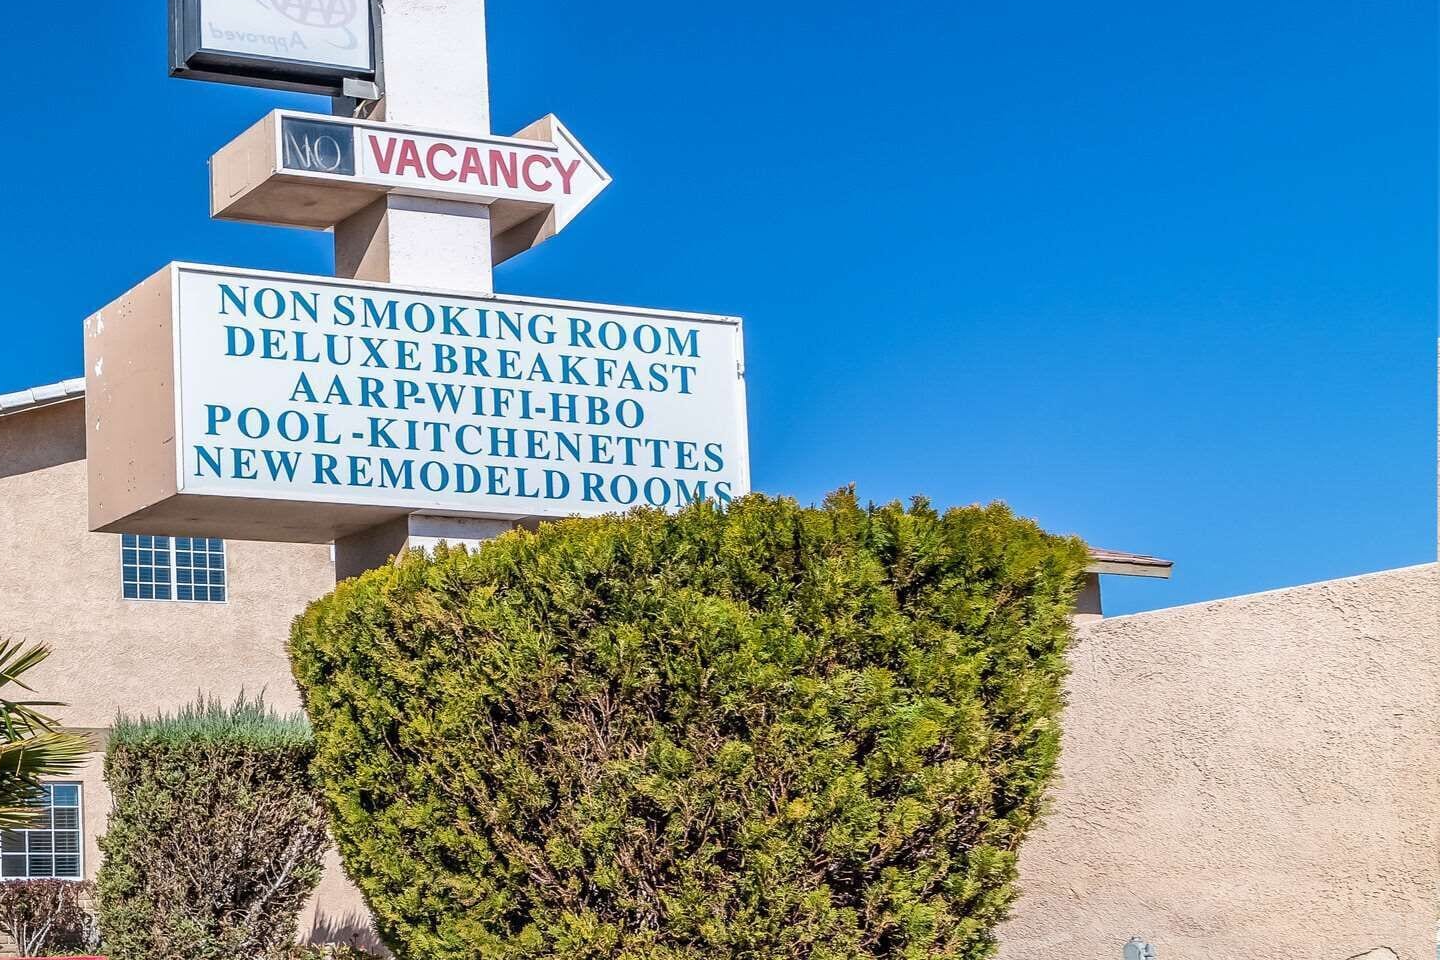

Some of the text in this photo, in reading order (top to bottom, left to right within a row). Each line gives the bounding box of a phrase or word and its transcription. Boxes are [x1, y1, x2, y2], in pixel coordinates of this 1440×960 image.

[368, 134, 581, 195] VACANCY
[218, 283, 701, 359] NON SMOKING ROOM
[224, 325, 697, 394] DELUXE BREAKFAST
[193, 445, 733, 510] NEW REMODELD ROOMS
